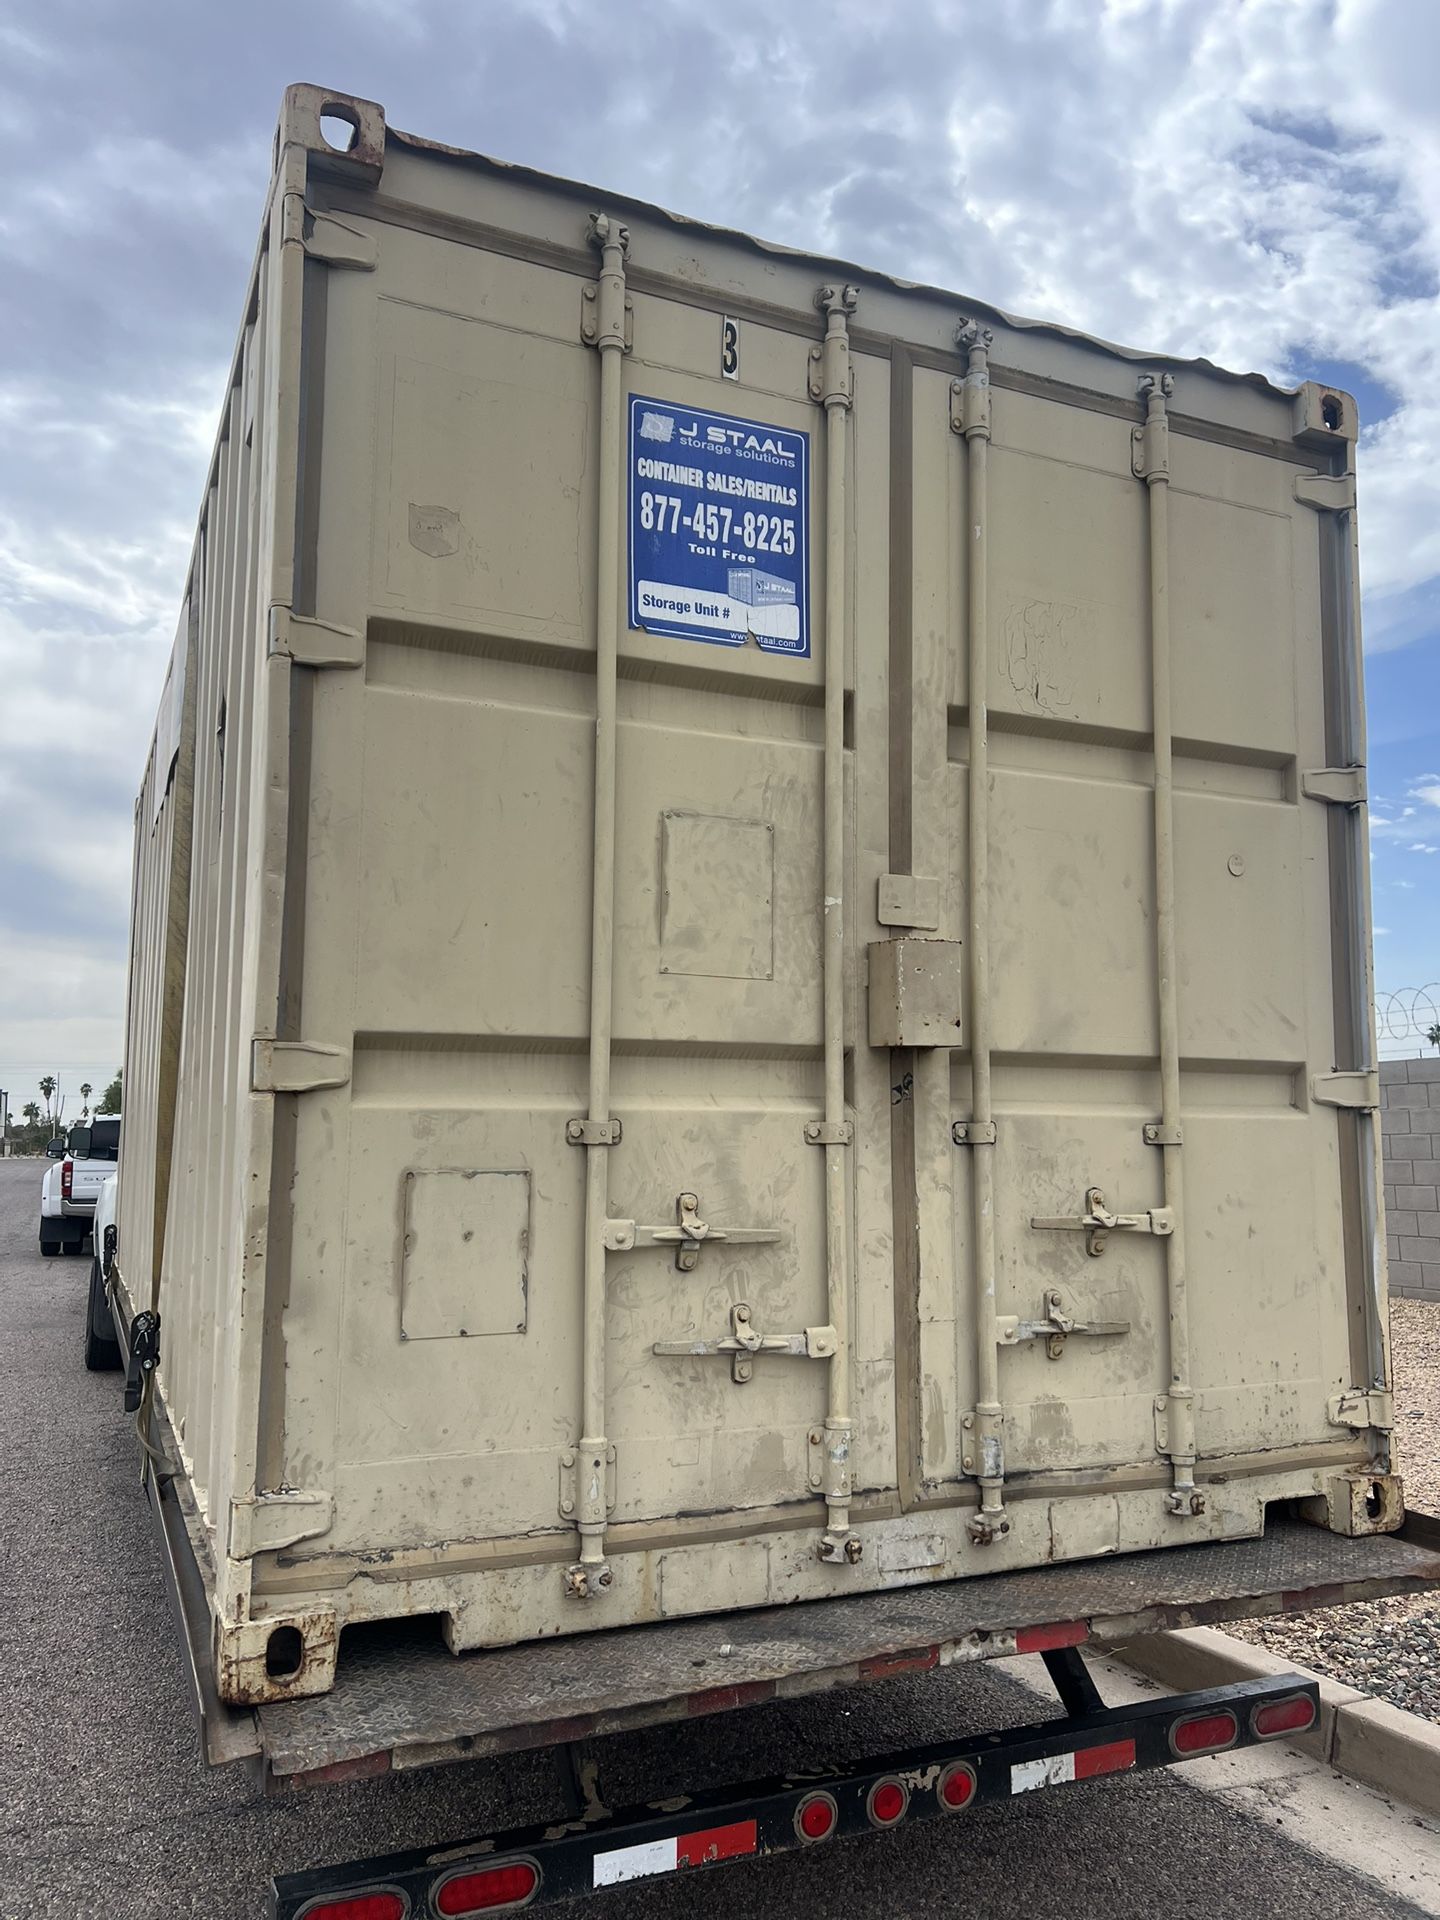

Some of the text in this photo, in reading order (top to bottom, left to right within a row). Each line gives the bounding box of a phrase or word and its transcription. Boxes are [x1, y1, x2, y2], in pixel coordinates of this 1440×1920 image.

[723, 322, 737, 374] 3
[679, 422, 795, 458] J STAAL
[680, 436, 796, 468] storage solutions
[637, 457, 797, 506] CONTAINER SALES/RENTALS
[640, 491, 796, 556] 877-457-8225
[687, 543, 756, 564] Toll Free
[642, 593, 730, 619] Storage Unit #
